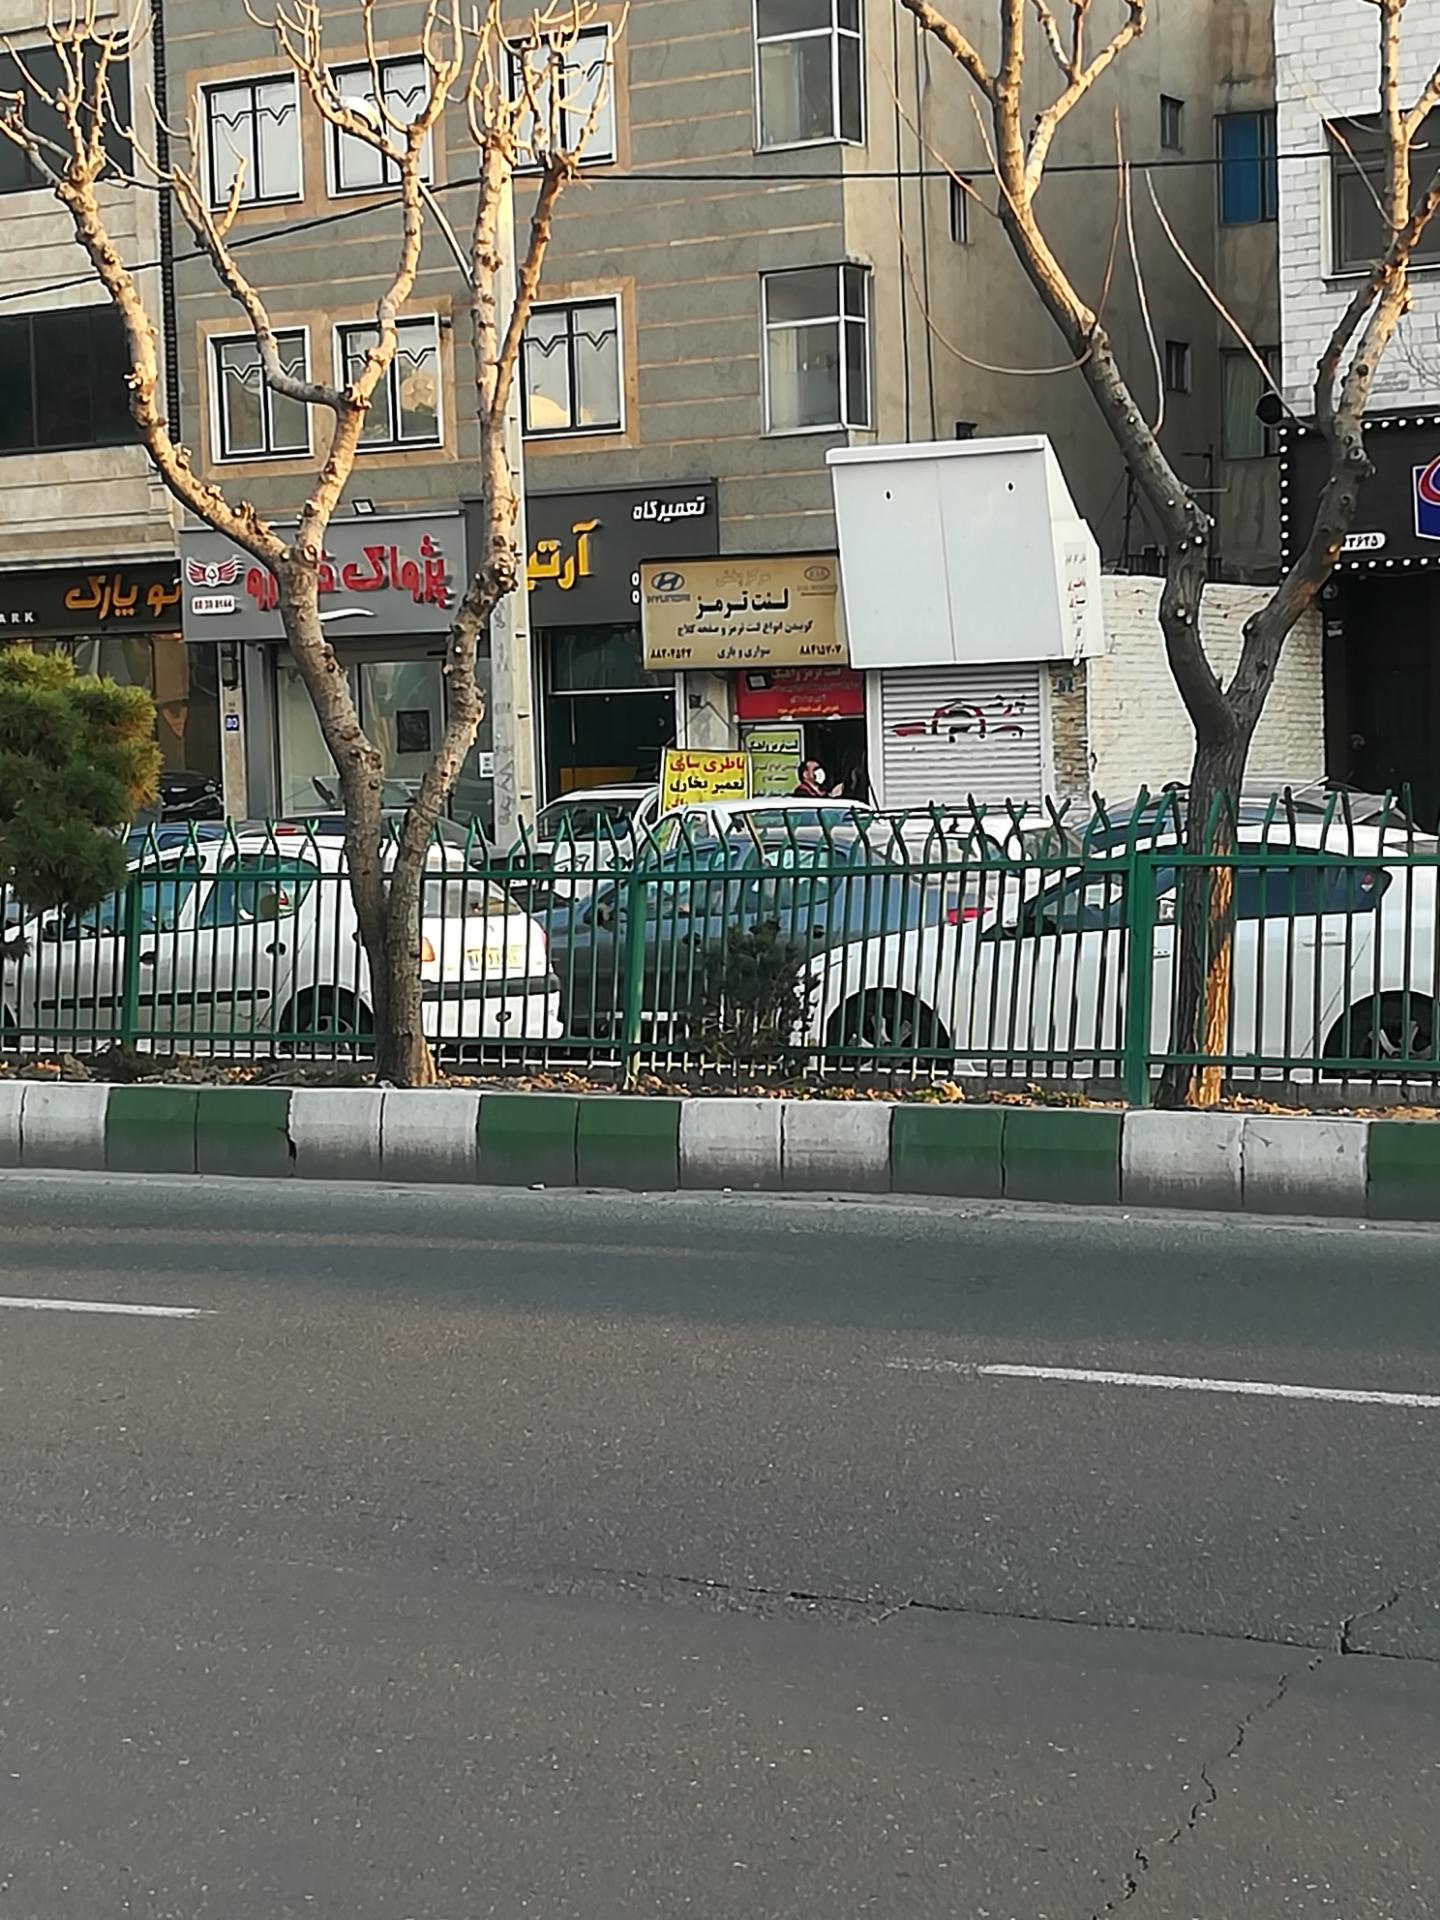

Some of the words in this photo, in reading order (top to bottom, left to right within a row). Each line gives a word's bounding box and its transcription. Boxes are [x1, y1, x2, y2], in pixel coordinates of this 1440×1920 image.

[633, 496, 705, 522] تعمیرگاه
[341, 534, 447, 609] پژواک
[65, 574, 138, 620] پارک
[695, 590, 748, 619] ترمز
[752, 588, 788, 611] لنت
[703, 756, 744, 773] باطری
[670, 775, 708, 792] بخاری
[711, 777, 745, 794] تعمیر
